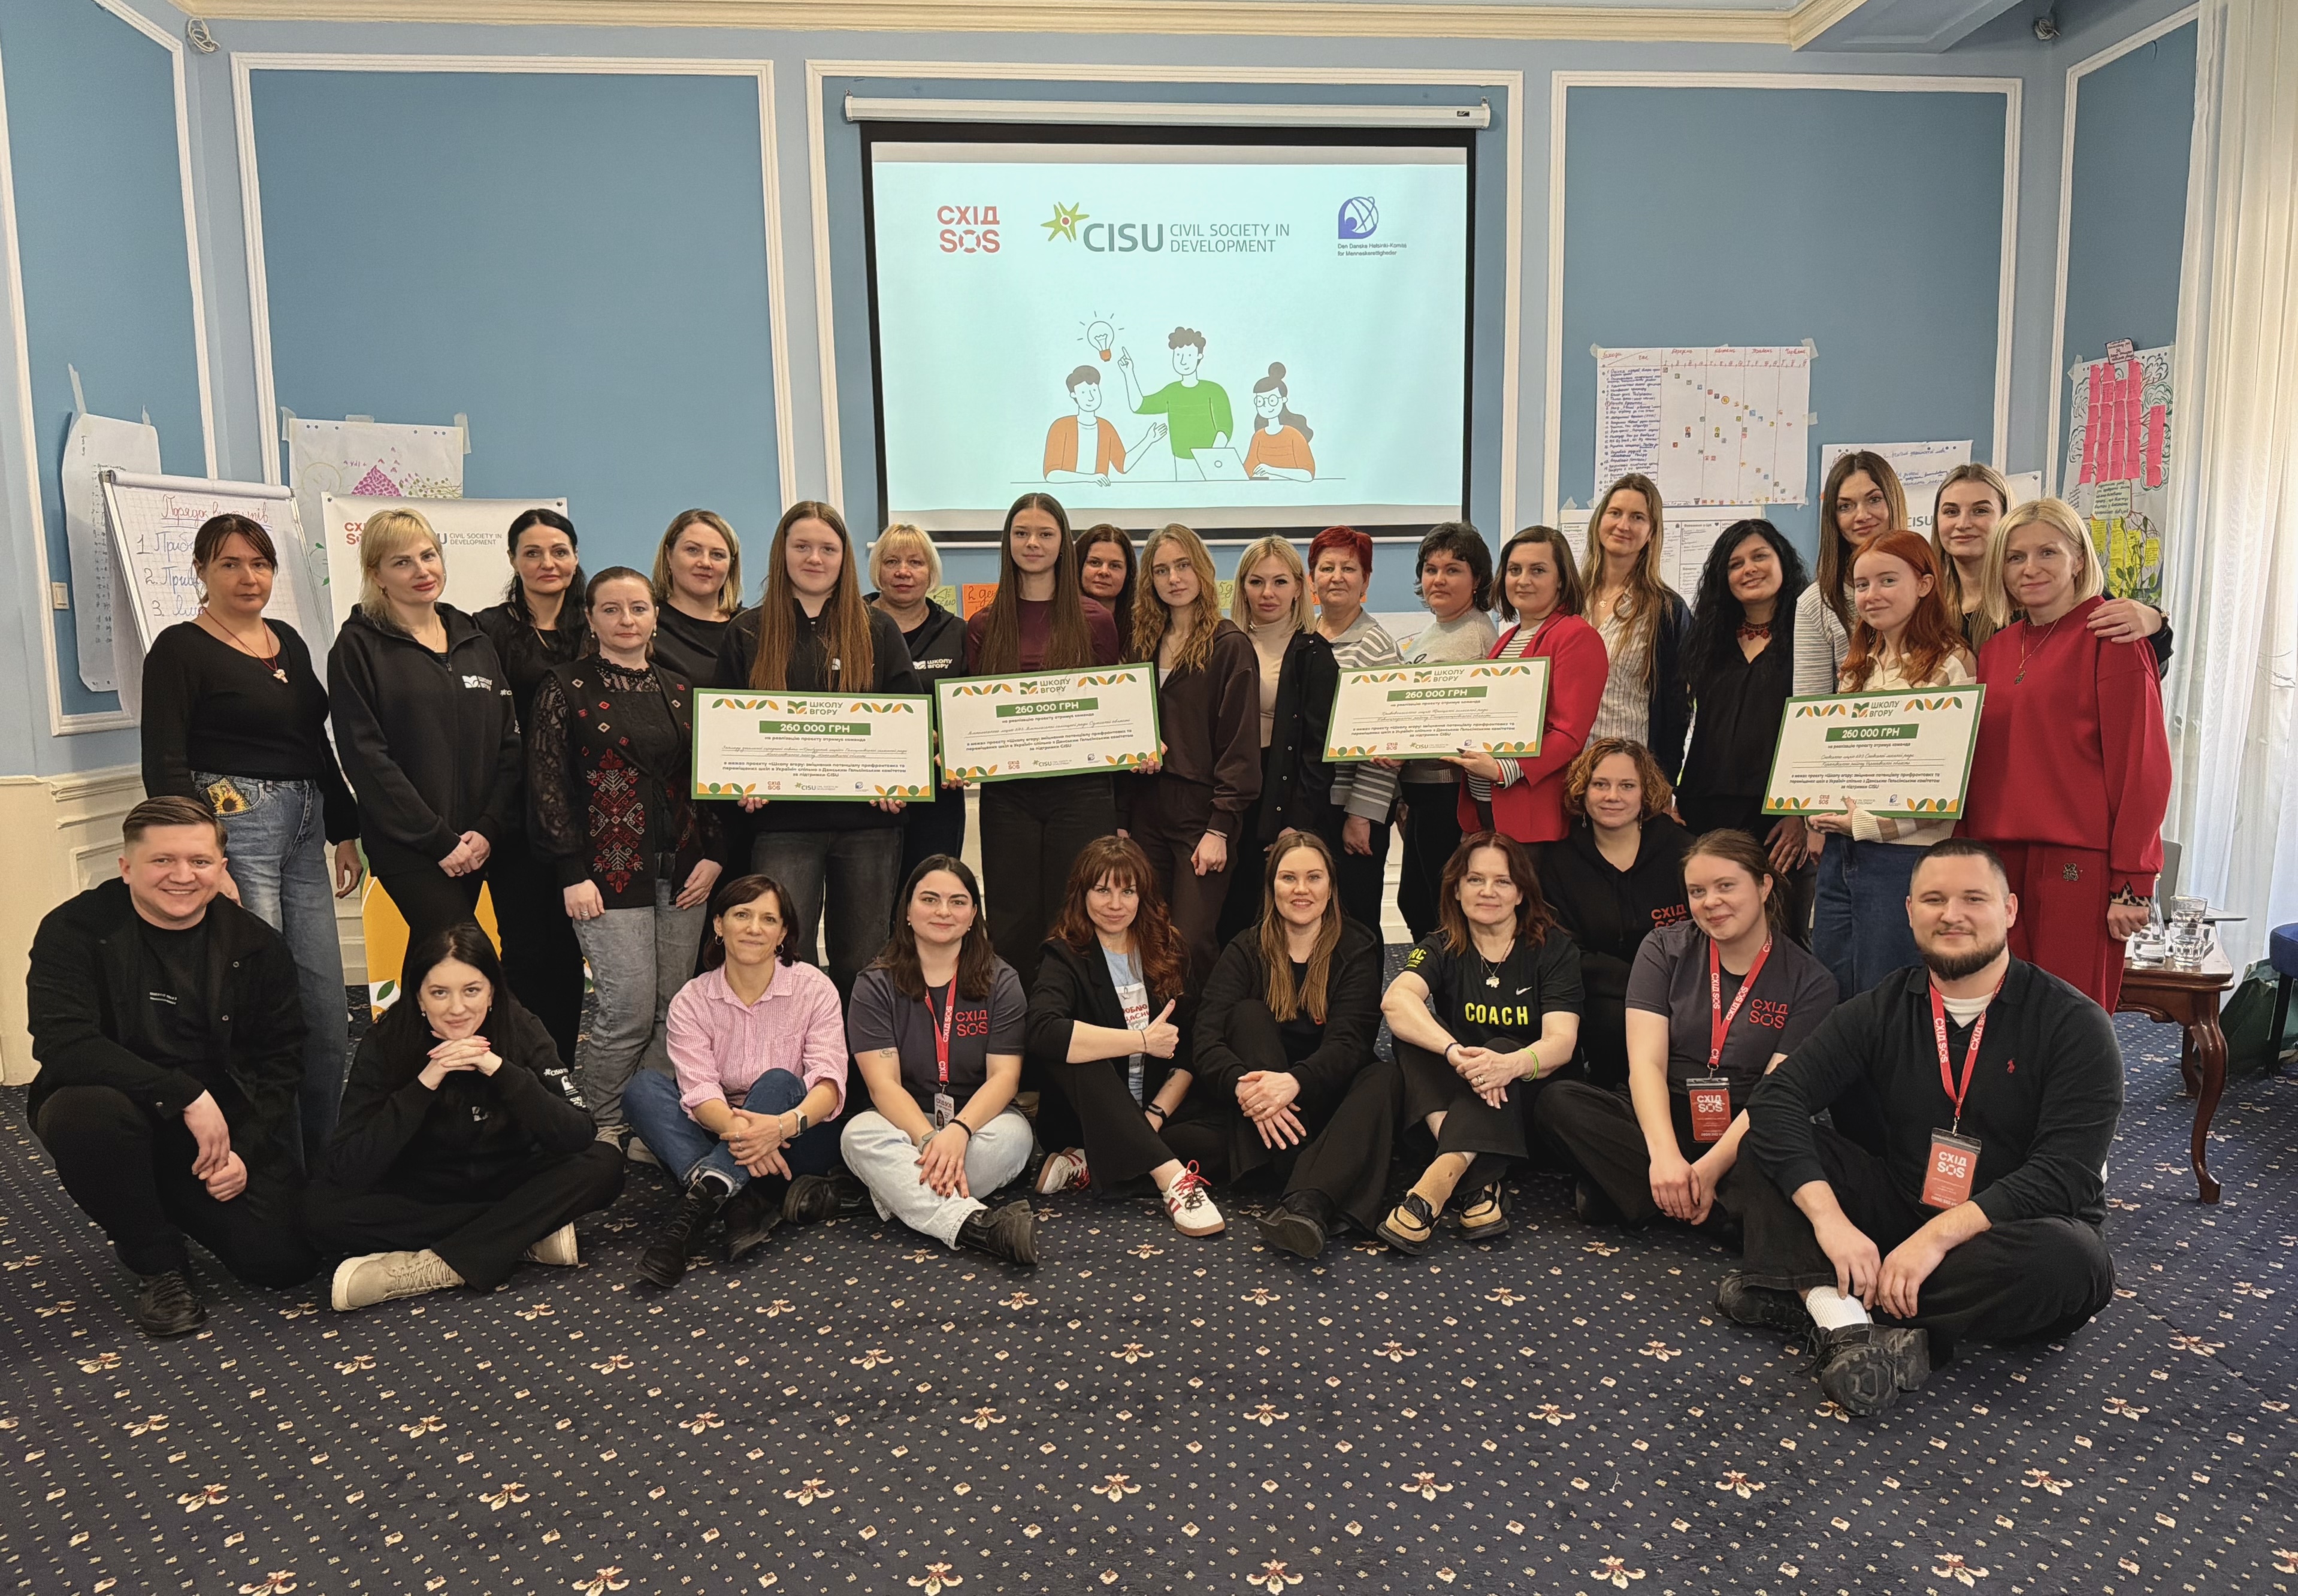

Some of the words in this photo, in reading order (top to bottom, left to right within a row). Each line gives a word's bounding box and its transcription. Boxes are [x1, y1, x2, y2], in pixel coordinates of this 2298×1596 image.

[937, 205, 1000, 225] СХІД
[1170, 224, 1205, 237] CIVIL
[1210, 224, 1269, 237] SOCIETY
[1276, 224, 1289, 236] IN
[939, 229, 1000, 253] SOS
[1083, 223, 1163, 252] CISU
[1171, 240, 1276, 253] DEVELOPMENT
[1040, 678, 1071, 687] ШКОЛУ
[1405, 690, 1423, 699] 260
[1425, 690, 1446, 698] 000
[1447, 688, 1468, 697] ГРН
[1015, 705, 1033, 714] 260
[1036, 703, 1057, 712] 000
[1059, 702, 1079, 711] ГРН
[1870, 700, 1900, 709] ШКОЛУ
[1869, 709, 1893, 718] ВГОРУ
[780, 723, 799, 733] 260
[803, 724, 826, 733] 000
[829, 724, 850, 733] ГРН
[1842, 729, 1858, 739] 260
[1860, 728, 1879, 737] 000
[1880, 727, 1900, 737] ГРН
[1651, 903, 1687, 921] СХІД
[1752, 999, 1788, 1015] СХІД
[955, 1010, 988, 1022] СХІД
[1465, 1002, 1528, 1026] COACH
[1749, 1010, 1786, 1029] SOS
[956, 1021, 988, 1037] SOS
[1934, 1017, 1947, 1042] СХІД
[1697, 1095, 1722, 1103] СХІД
[1698, 1103, 1724, 1113] SOS
[1939, 1151, 1967, 1167] СХІД
[1937, 1161, 1965, 1178] SOS
